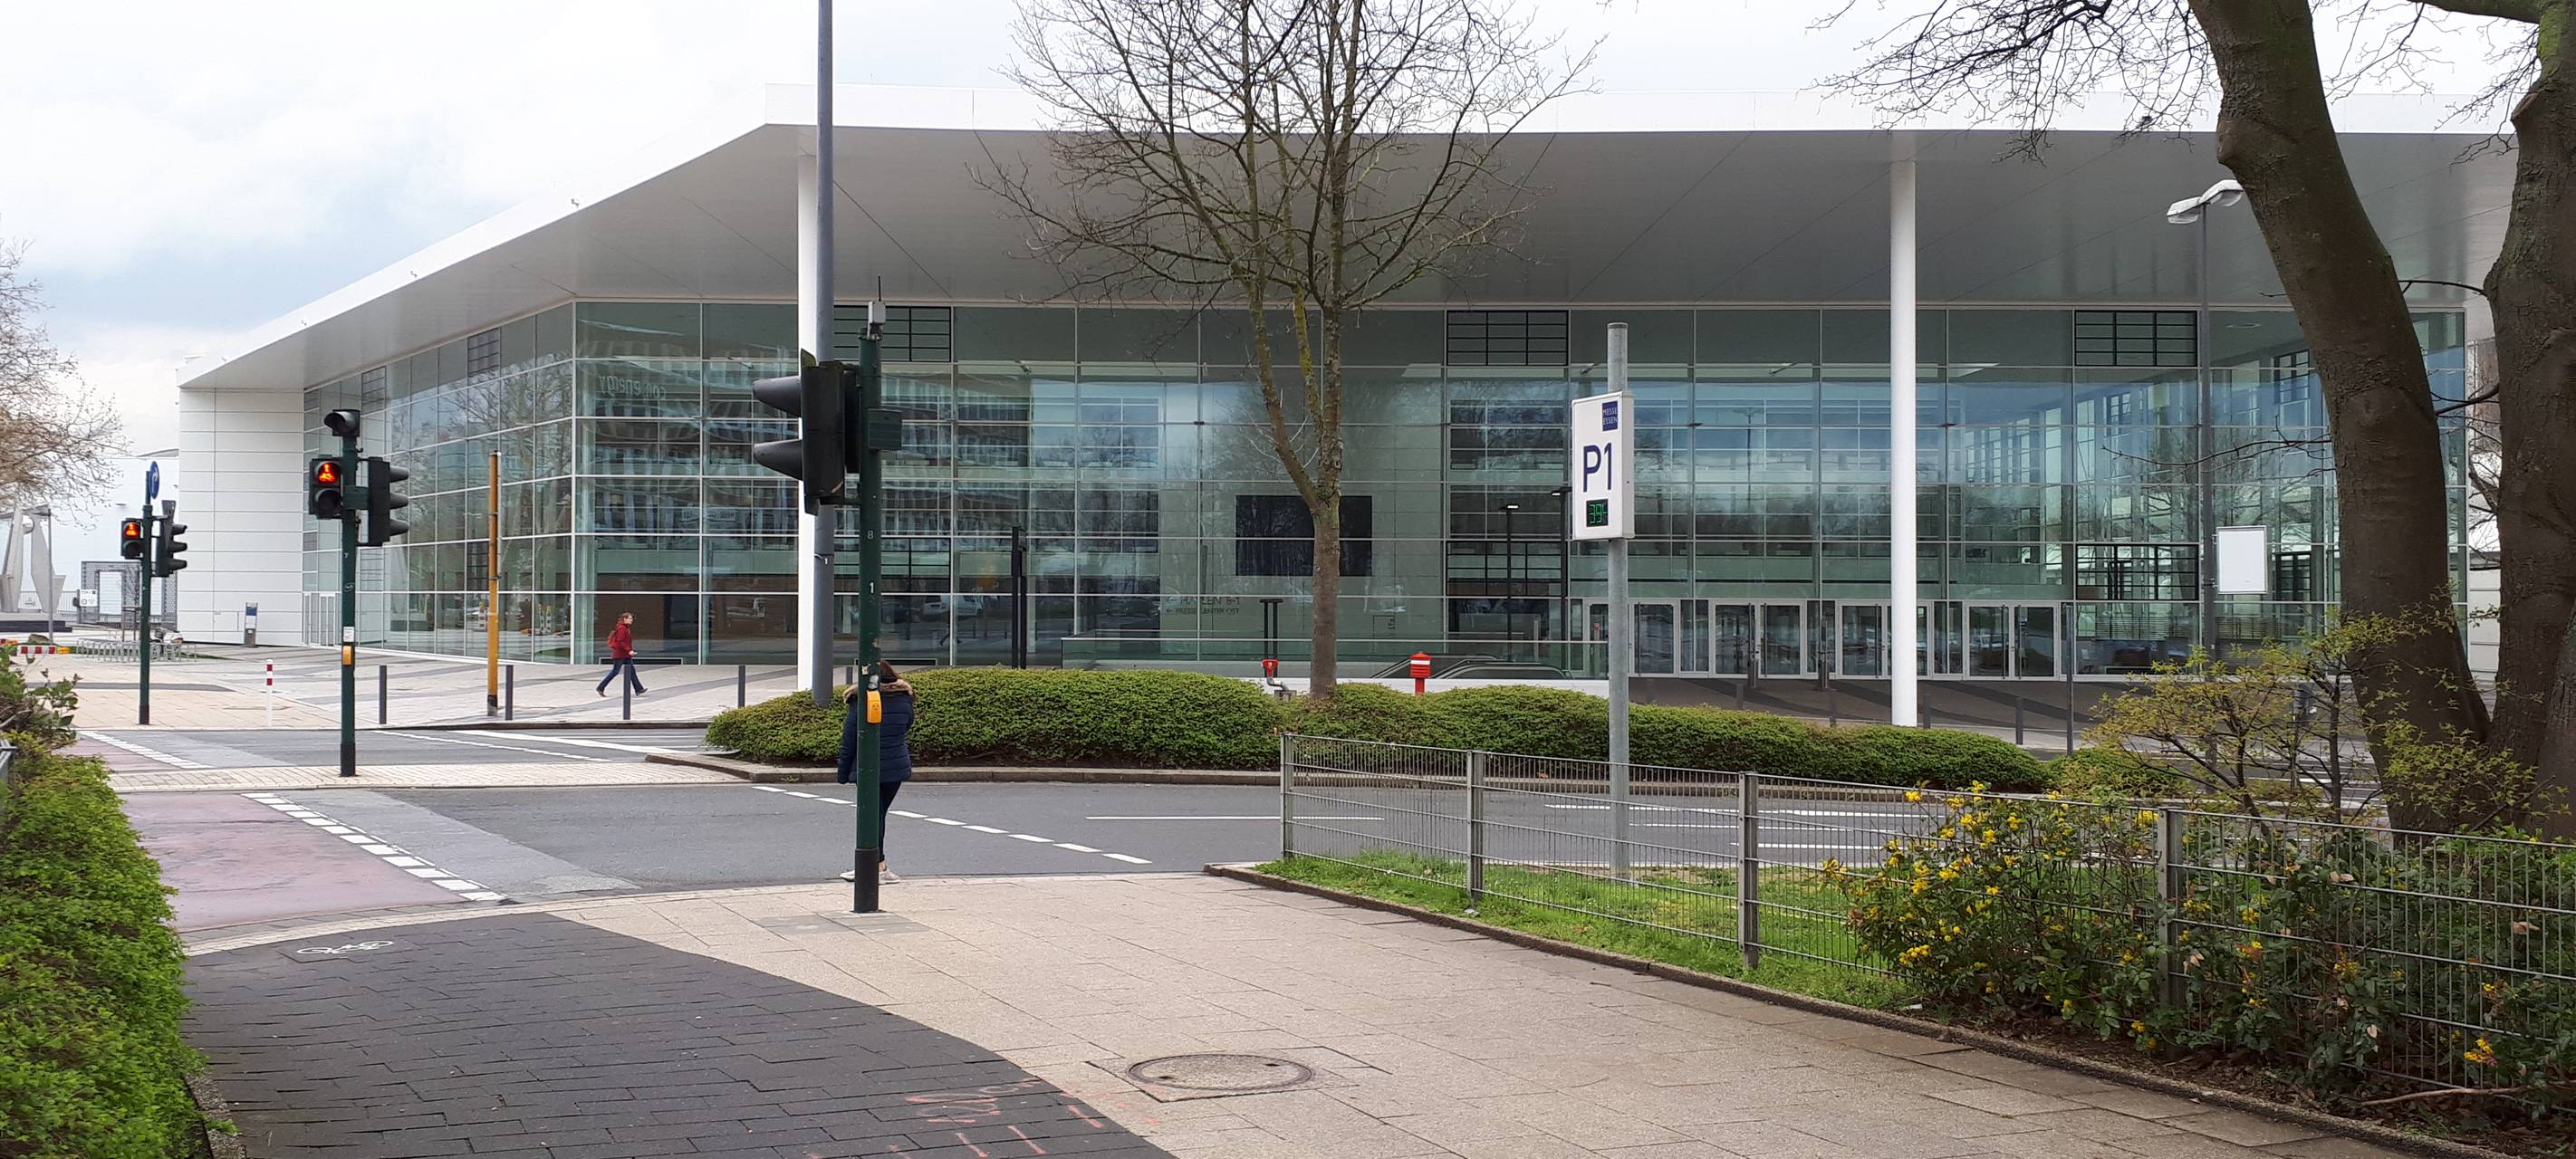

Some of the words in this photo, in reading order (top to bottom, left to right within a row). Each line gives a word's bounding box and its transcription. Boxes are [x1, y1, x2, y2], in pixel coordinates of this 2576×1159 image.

[1603, 407, 1617, 416] MESSE
[1603, 417, 1618, 425] ESSEN
[1583, 442, 1612, 493] P1
[868, 531, 874, 539] 8
[870, 582, 874, 593] 1
